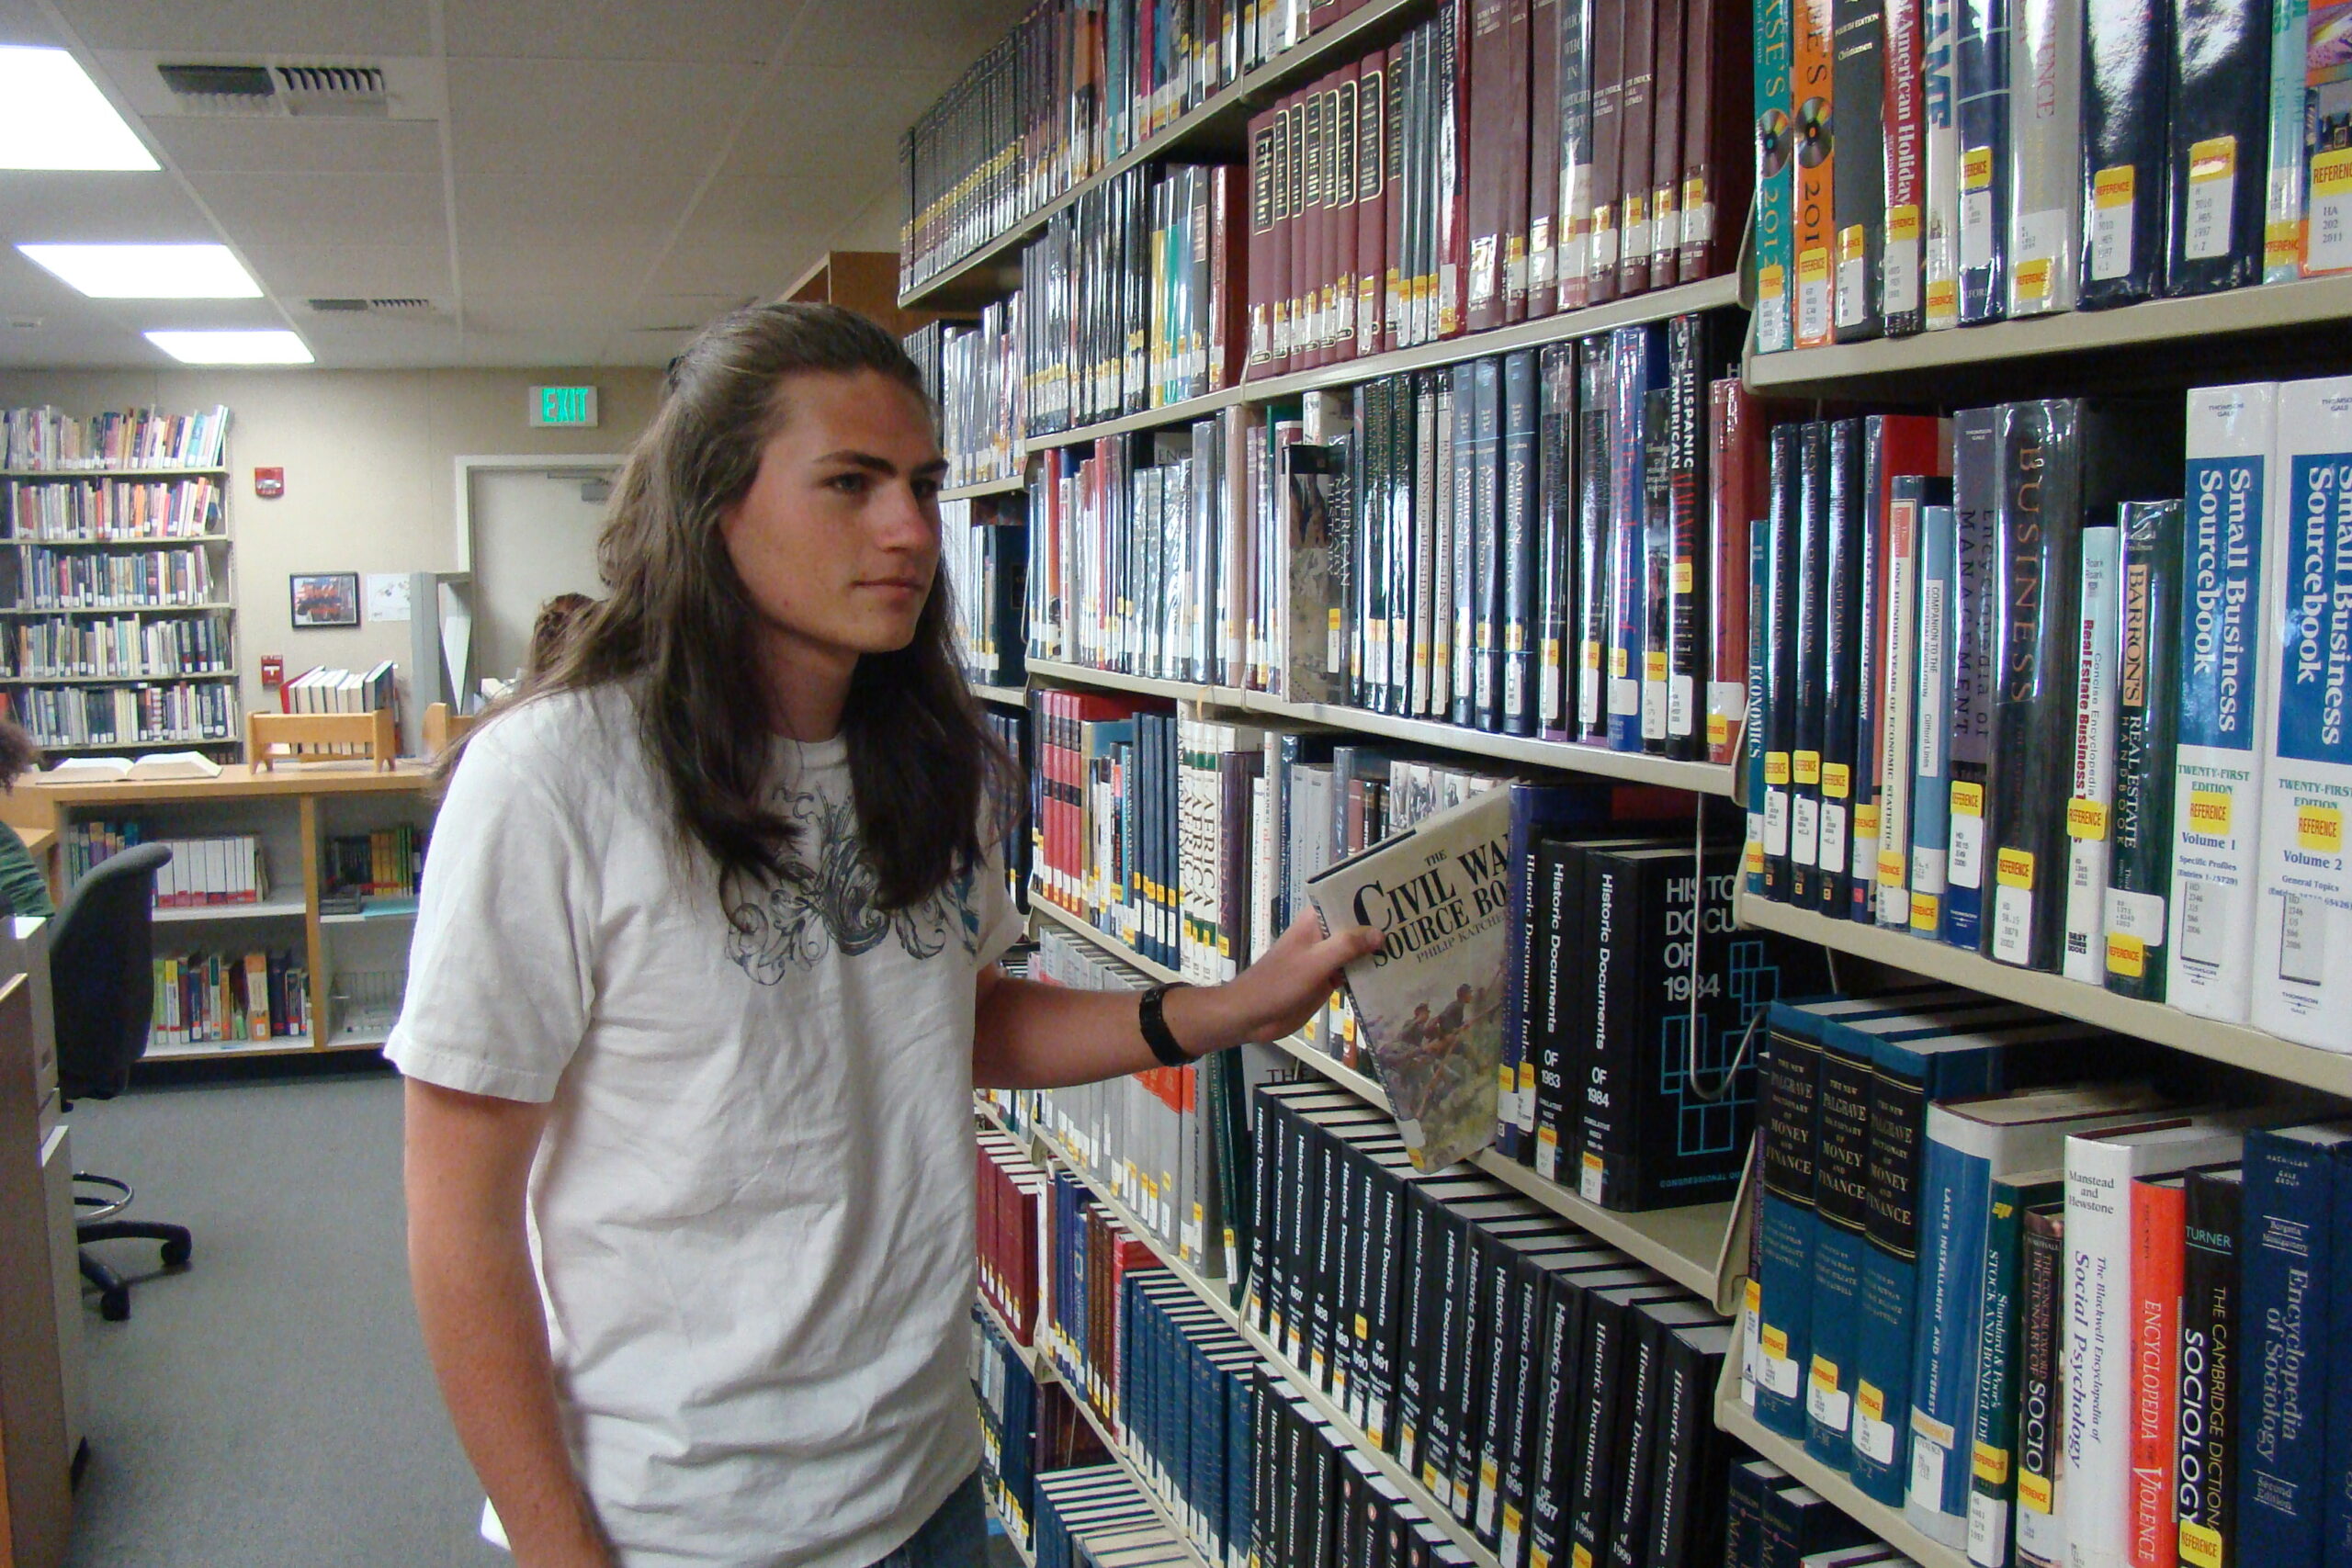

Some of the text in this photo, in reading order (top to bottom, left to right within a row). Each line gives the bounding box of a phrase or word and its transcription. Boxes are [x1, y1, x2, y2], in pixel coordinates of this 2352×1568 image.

[1894, 16, 1916, 207] American Holiday
[2097, 181, 2130, 197] REFERENCE
[2324, 206, 2338, 216] HA
[2324, 220, 2338, 230] 202
[2323, 233, 2343, 243] 2011
[543, 388, 588, 423] EXIT
[1670, 375, 1681, 469] AMERICAN
[1682, 372, 1695, 468] HISPANIC
[1340, 472, 1351, 586] AMERICAN
[1485, 465, 1493, 547] AMERICAN
[1515, 460, 1525, 545] AMERICAN
[1419, 535, 1429, 623] PRESIDENT
[1439, 535, 1449, 624] PRESIDENT
[1804, 571, 1815, 654] CAPITALISM
[1834, 569, 1845, 654] CAPITALISM
[2010, 447, 2041, 702] BUSINESS
[2193, 469, 2223, 675] Sourcebook
[2218, 468, 2253, 733] Small Business
[2296, 467, 2334, 684] Sourcebook
[2321, 465, 2352, 745] Small Business
[1929, 586, 1939, 674] COMPANION TO THE
[2124, 570, 2144, 702] BARRON'S
[1749, 665, 1763, 758] ECONOMICS
[1860, 666, 1870, 721] ECONOMY
[2076, 619, 2095, 789] Real Estate Business
[2087, 652, 2103, 797] Concise Encyclopedia
[1885, 716, 1895, 851] ECONOMIC STATISTICS
[2117, 716, 2129, 845] HANDBOOK
[2123, 716, 2143, 849] REAL ESTATE
[2177, 764, 2250, 781] TWENTY-FIRST
[2189, 802, 2227, 821] REFERENCE
[2191, 781, 2233, 795] EDITION
[1193, 793, 1204, 904] AFRICA
[1204, 795, 1216, 908] AFRICA
[1424, 849, 1448, 866] THE
[2069, 807, 2102, 827] REFERENCE
[2182, 832, 2236, 851] Volume 1
[2298, 818, 2337, 838] REFERENCE
[1353, 868, 1456, 932] CIVIL
[2179, 855, 2237, 872] Specific Profiles
[2282, 874, 2312, 887] General
[2314, 880, 2340, 893] Topics
[2283, 850, 2343, 871] Volume 2
[1371, 898, 1470, 968] SOURCE
[1417, 938, 1455, 964] PHILIP
[1521, 853, 1535, 1063] Historic Documents Index
[1547, 863, 1564, 1033] Historic Documents
[1596, 873, 1613, 1051] Historic Documents
[2108, 945, 2140, 962] REFERENCE
[2183, 964, 2217, 976] THOMSON
[2282, 992, 2318, 1005] THOMSON
[1541, 1069, 1561, 1089] 1983
[1544, 1049, 1559, 1067] OF
[1587, 1087, 1610, 1108] 1984
[1591, 1066, 1608, 1086] OF
[1771, 1118, 1808, 1144] MONEY
[1823, 1092, 1867, 1122] PALGRAVE
[1660, 1173, 1727, 1189] CONGRESSIONAL
[1766, 1145, 1812, 1175] FINANCE
[1818, 1169, 1866, 1200] FINANCE
[1823, 1140, 1863, 1168] MONEY
[1871, 1162, 1908, 1192] MONEY
[2069, 1170, 2115, 1189] Manstead
[2080, 1188, 2098, 1199] and
[2275, 1178, 2300, 1187] GROUP
[1319, 1148, 1331, 1272] Historic Documents
[1338, 1160, 1351, 1308] Historic Documents
[1358, 1176, 1373, 1308] Historic Documents
[1866, 1190, 1911, 1225] FINANCE
[2069, 1195, 2114, 1214] Hewstone
[2186, 1225, 2232, 1247] TURNER
[1378, 1191, 1394, 1326] Historic Documents
[1409, 1209, 1424, 1347] Historic Documents
[1439, 1229, 1455, 1392] Historic Documents
[1461, 1247, 1480, 1414] Historic Documents
[1928, 1188, 1951, 1415] LAKE'S INSTALLMENT AND INTEREST
[1982, 1248, 1999, 1391] STOCK AND BOND
[2030, 1251, 2043, 1375] DICTIONARY OF
[1352, 1349, 1368, 1371] 1990
[1372, 1350, 1389, 1372] 1991
[1487, 1266, 1507, 1437] Historic Documents
[1513, 1282, 1533, 1457] Historic Documents
[1542, 1302, 1566, 1483] Historic Documents
[1990, 1292, 2008, 1408] Standard Poor's
[2068, 1250, 2089, 1469] Social Psychology
[2089, 1257, 2106, 1444] The Blackwell Encyclopedia of
[2208, 1286, 2227, 1437] THE CAMBRIDGE
[2256, 1306, 2285, 1463] of Sociology
[2280, 1266, 2309, 1441] Encyclopedia
[1584, 1321, 1606, 1499] Historic Documents
[1623, 1342, 1649, 1525] Historic Documents
[2132, 1299, 2163, 1562] ENCYCLOPEDIA VIOLENCE
[2180, 1328, 2204, 1526] SOCIOLOGY
[1660, 1369, 1683, 1557] Historic Documents
[2256, 1488, 2292, 1511] Edition
[2257, 1476, 2293, 1498] Second
[1575, 1519, 1595, 1543] 1998
[1613, 1541, 1632, 1565] 1999
[2181, 1531, 2218, 1558] REFERENCE
